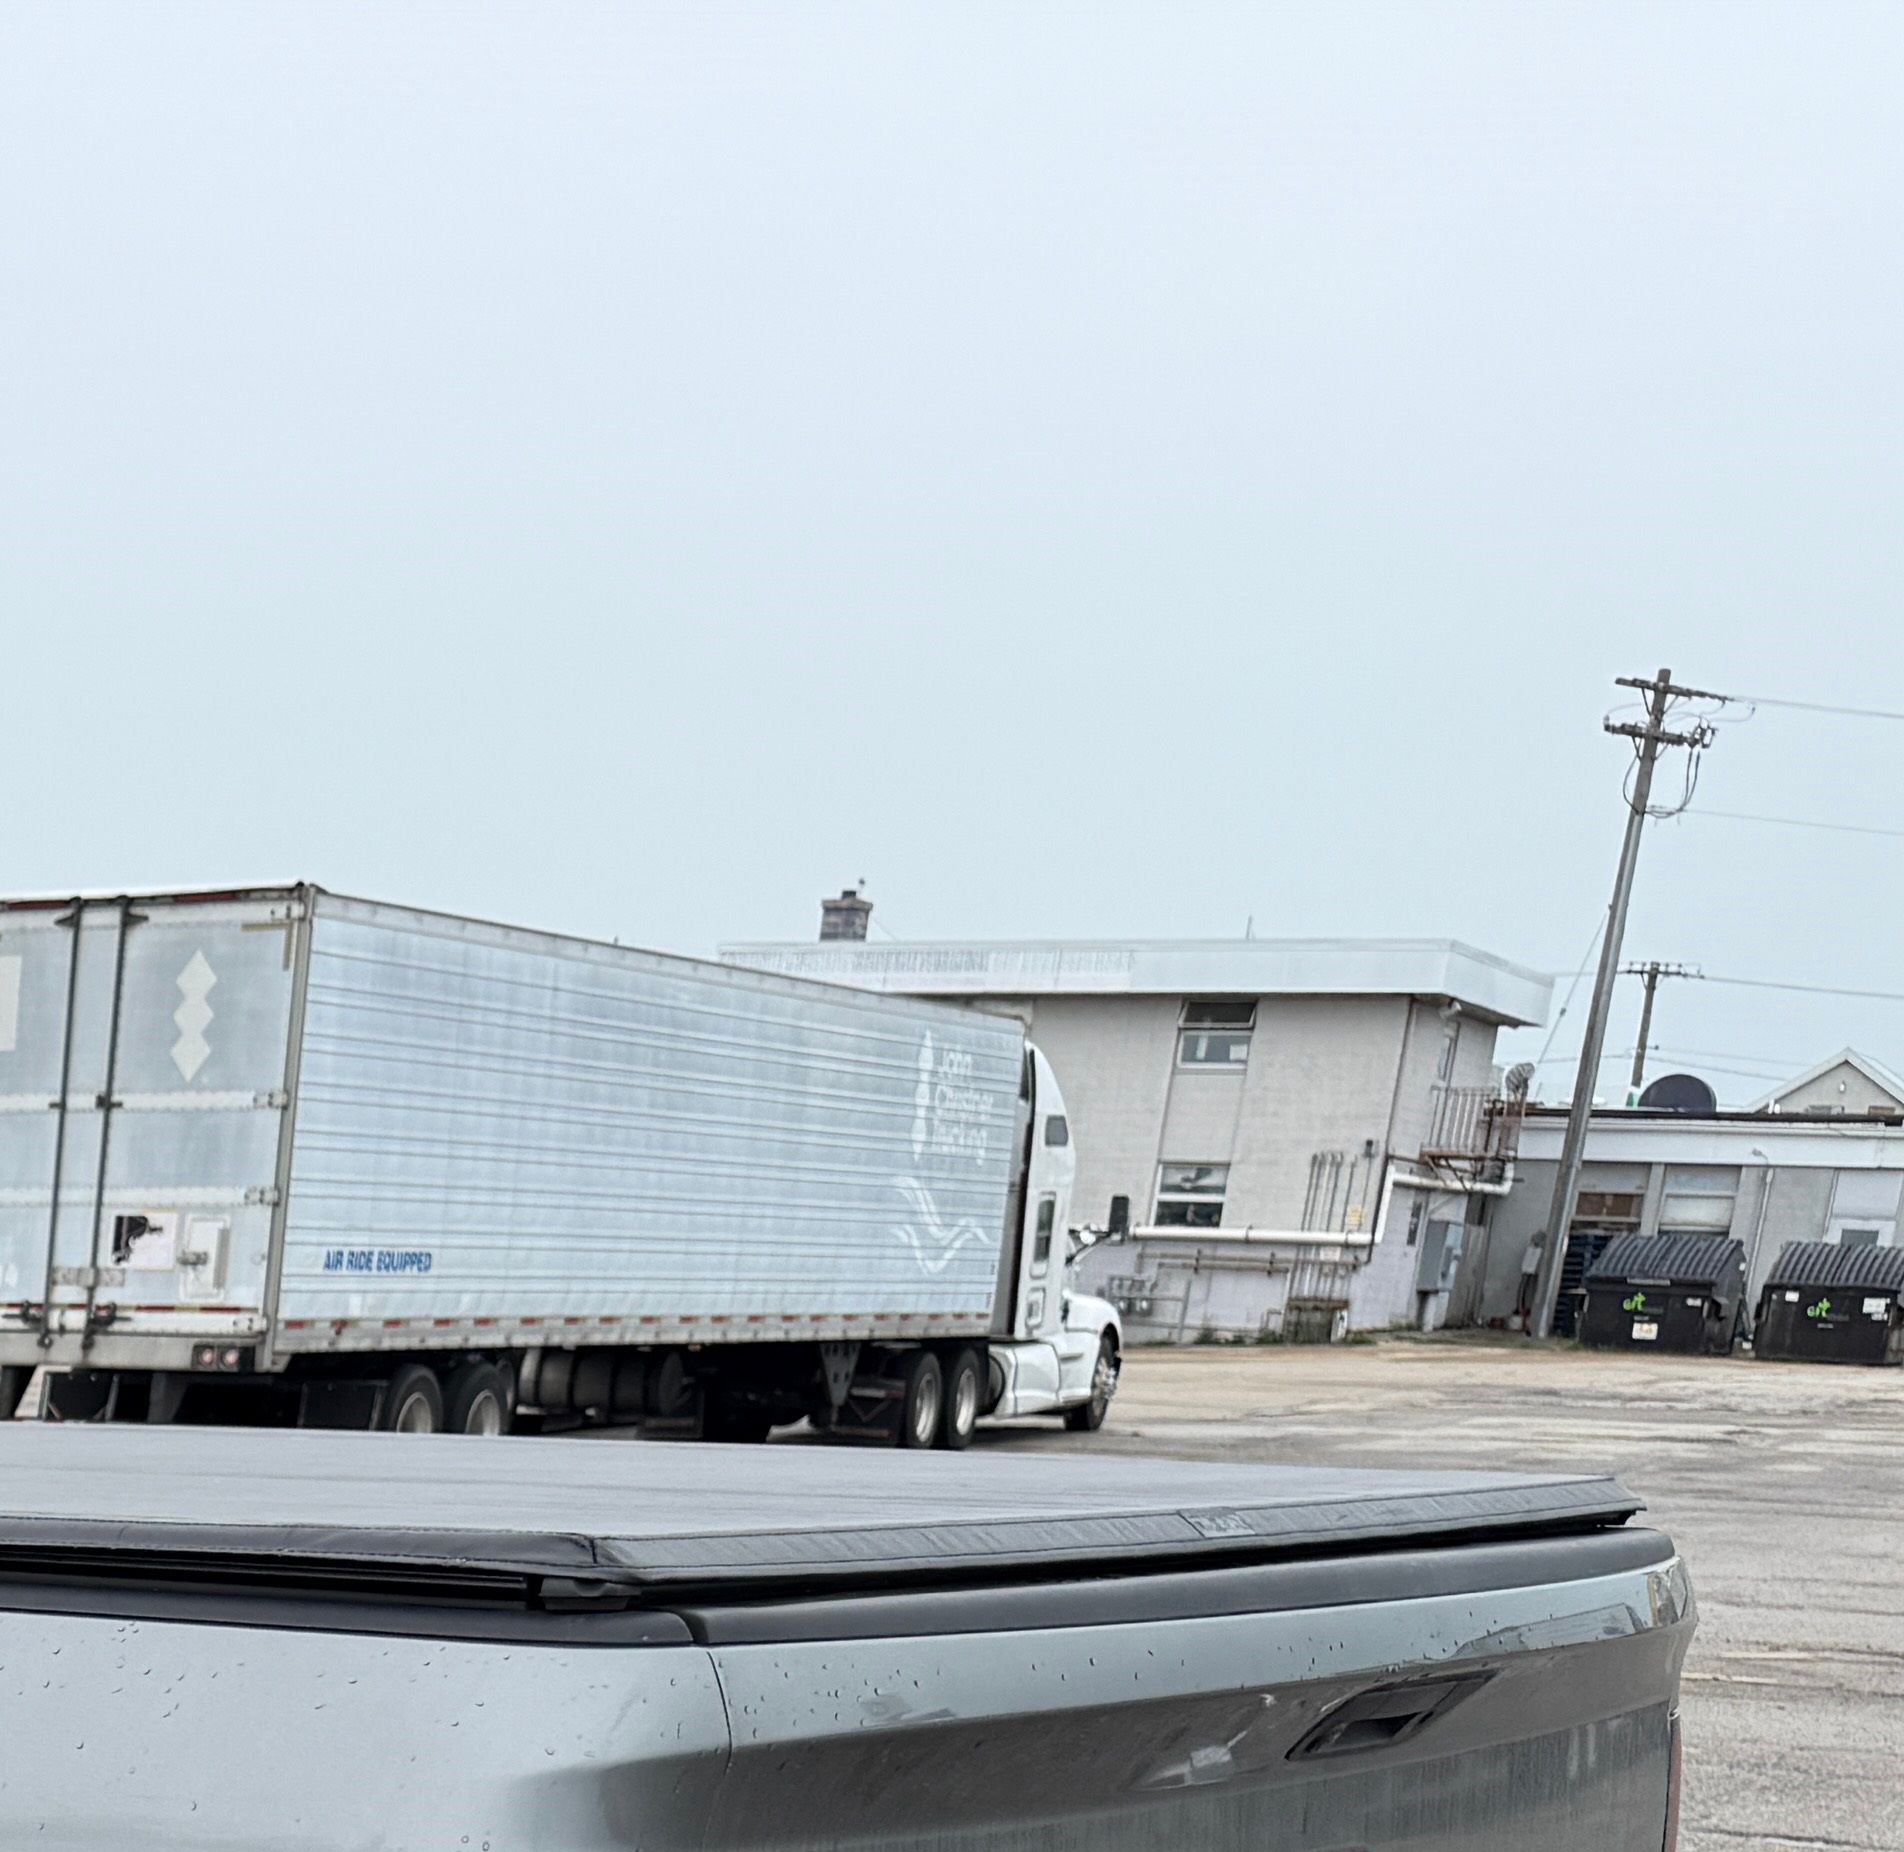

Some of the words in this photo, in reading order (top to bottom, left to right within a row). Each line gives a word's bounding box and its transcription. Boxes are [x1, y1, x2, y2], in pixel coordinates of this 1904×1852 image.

[323, 1249, 344, 1271] AIR
[346, 1250, 374, 1272] RIDE
[376, 1250, 432, 1272] EQUIPPED
